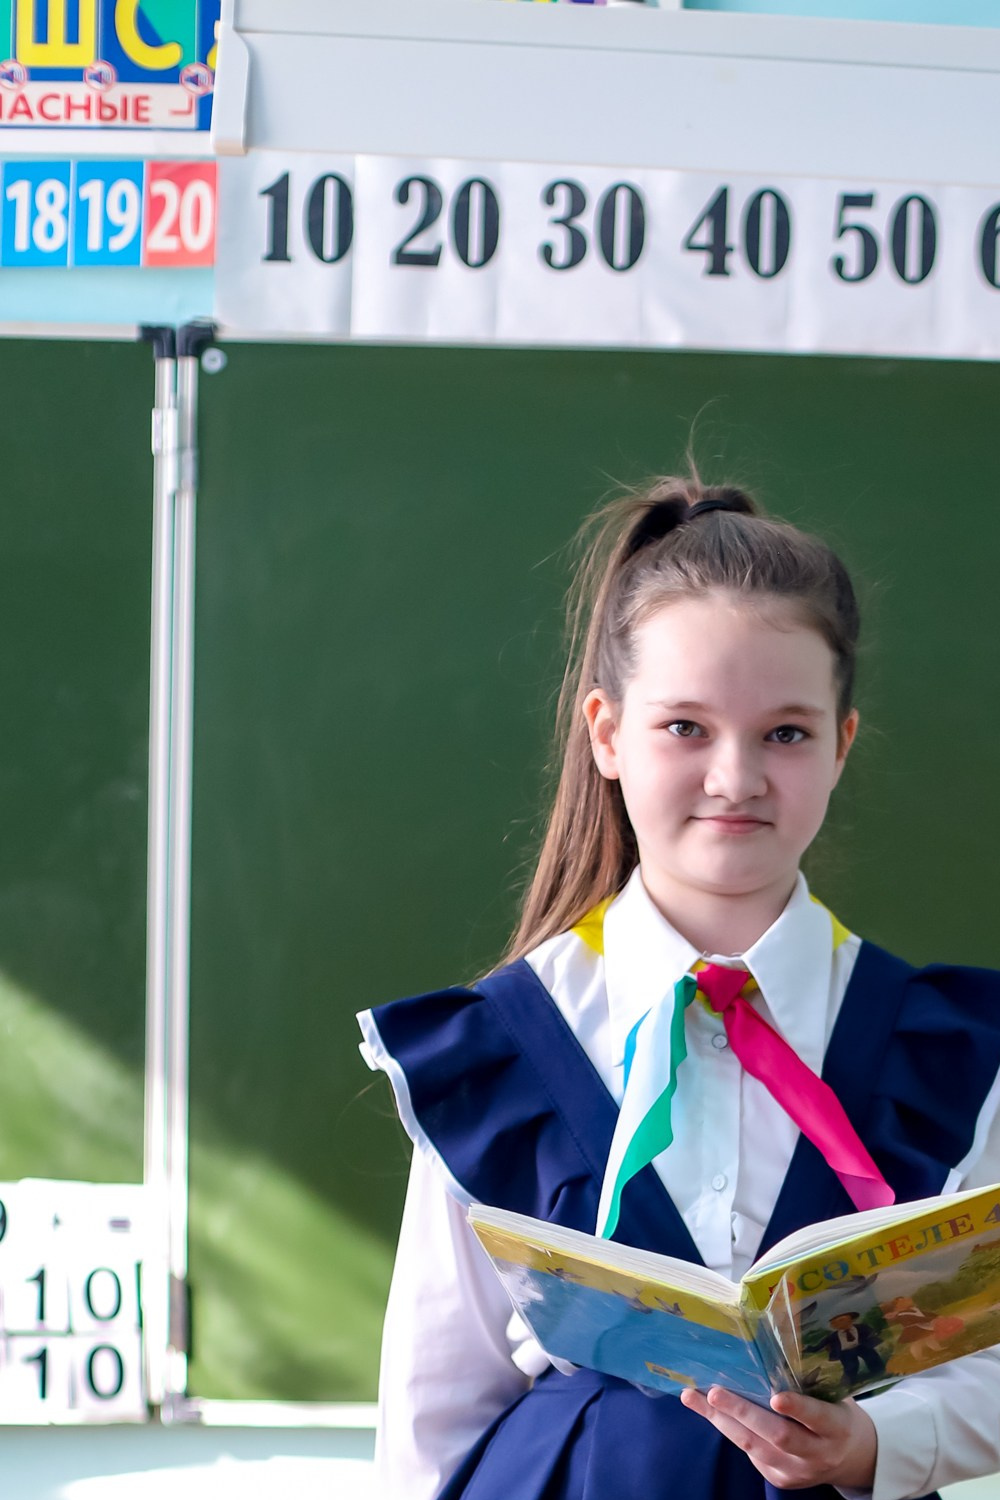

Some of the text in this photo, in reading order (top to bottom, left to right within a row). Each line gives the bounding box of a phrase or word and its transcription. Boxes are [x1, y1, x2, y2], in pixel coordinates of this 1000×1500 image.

[0, 92, 151, 123] АСНЫЕ
[6, 178, 214, 253] 18 19 20
[259, 171, 354, 263] 10
[390, 174, 500, 268] 20
[541, 178, 645, 271] 30
[683, 185, 791, 278] 40
[831, 193, 937, 284] 50
